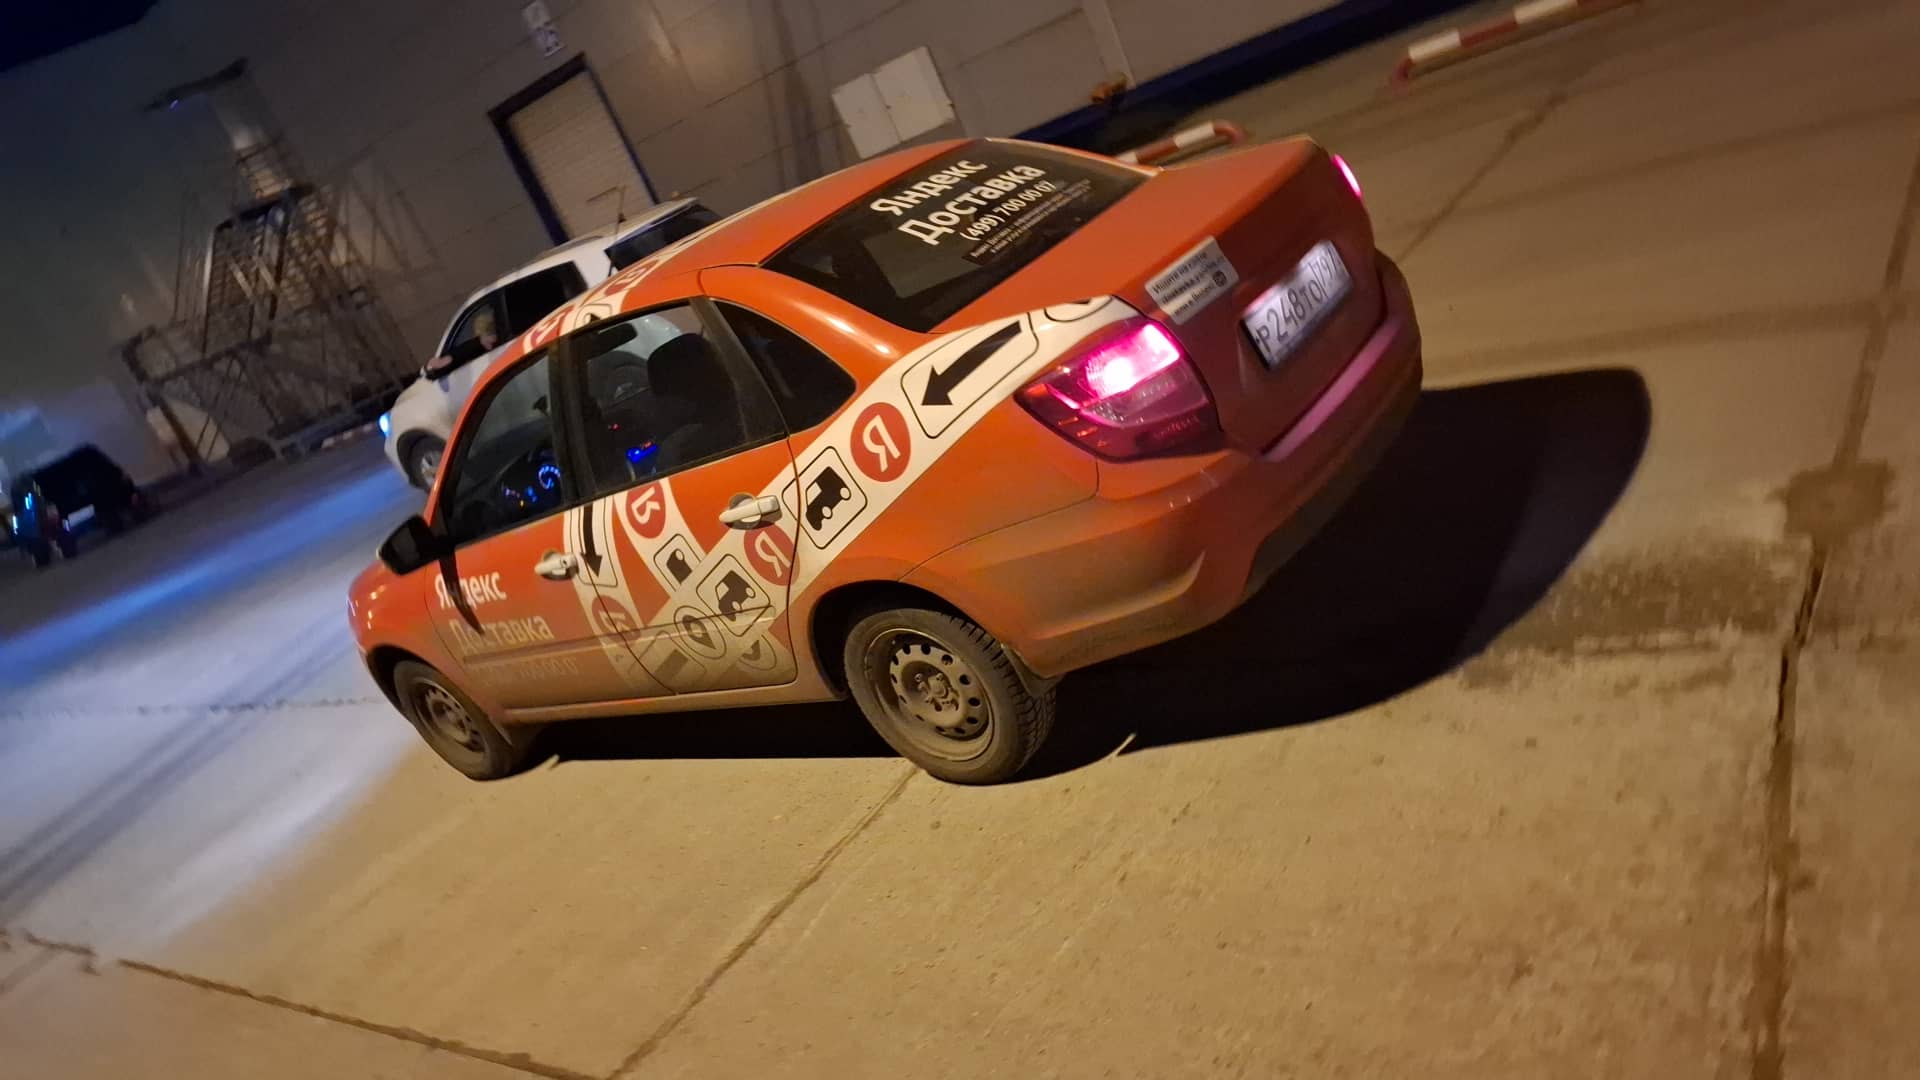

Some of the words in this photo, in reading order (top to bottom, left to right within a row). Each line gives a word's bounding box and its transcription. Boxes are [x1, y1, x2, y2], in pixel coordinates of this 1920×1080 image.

[870, 160, 988, 216] Яндекс
[897, 165, 1046, 246] Доставка
[960, 214, 1005, 241] (499)
[992, 199, 1027, 216] 700
[1017, 189, 1043, 201] 00
